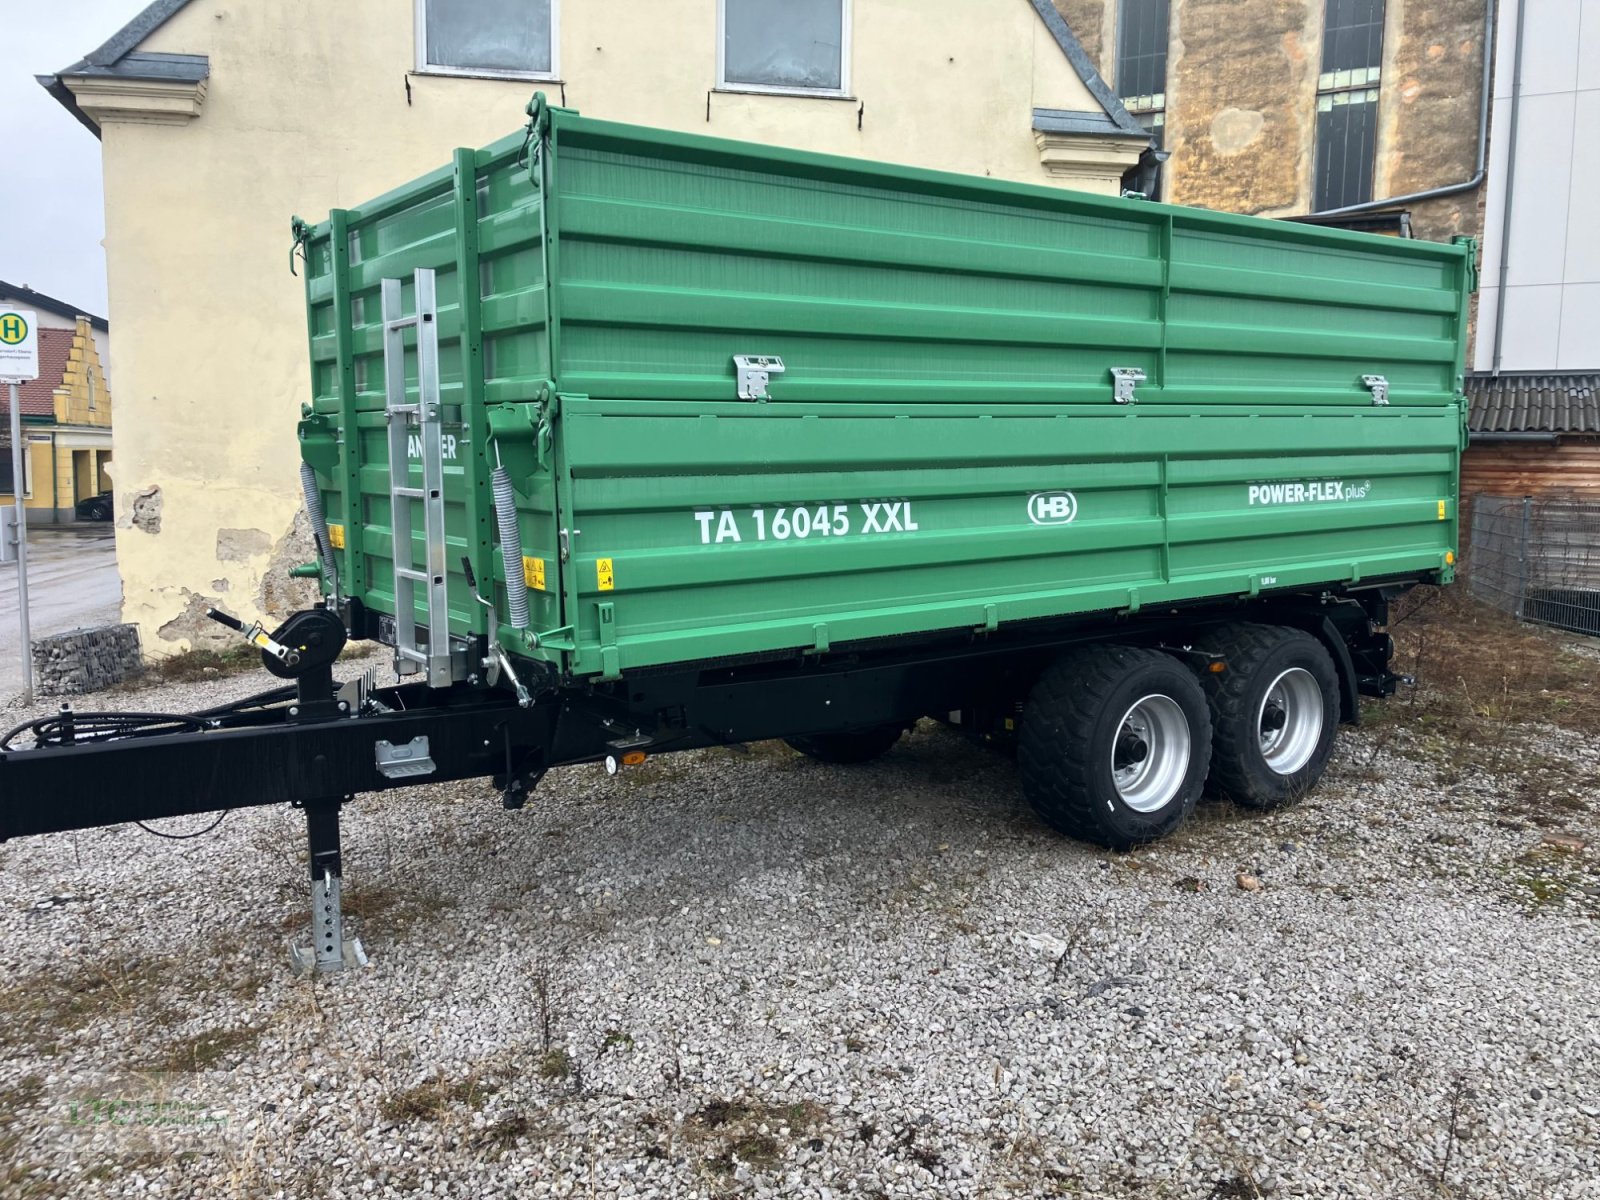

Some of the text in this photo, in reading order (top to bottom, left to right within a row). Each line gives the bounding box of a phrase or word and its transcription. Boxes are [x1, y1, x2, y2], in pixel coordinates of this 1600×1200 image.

[3, 319, 20, 339] H
[1248, 481, 1344, 505] POWER-FLEX
[1037, 496, 1071, 519] HB
[694, 501, 919, 544] TA 16045 XXL
